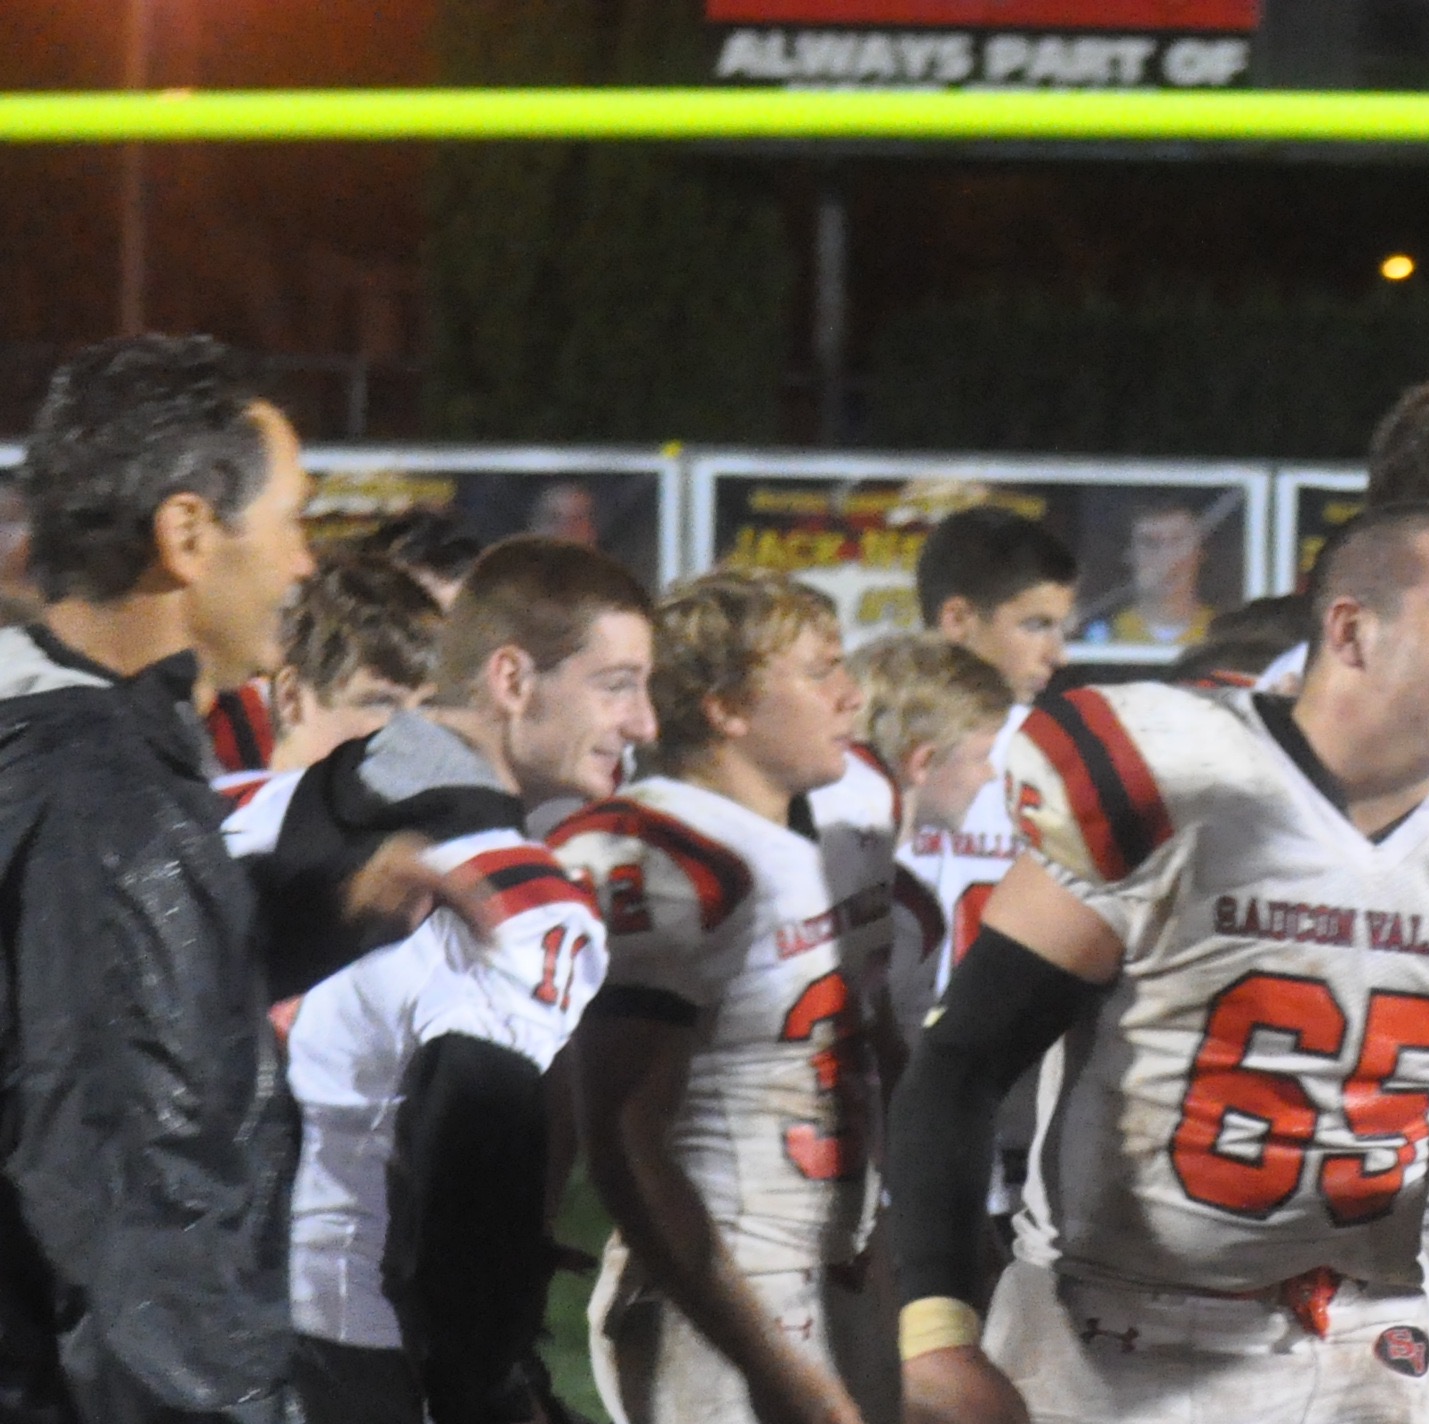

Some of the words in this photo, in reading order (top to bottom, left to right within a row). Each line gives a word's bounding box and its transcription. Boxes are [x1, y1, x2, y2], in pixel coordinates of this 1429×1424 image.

[714, 27, 974, 81] ALWAYS
[983, 33, 1156, 83] PART
[1161, 37, 1251, 86] OF
[1214, 895, 1355, 947] SAUCON
